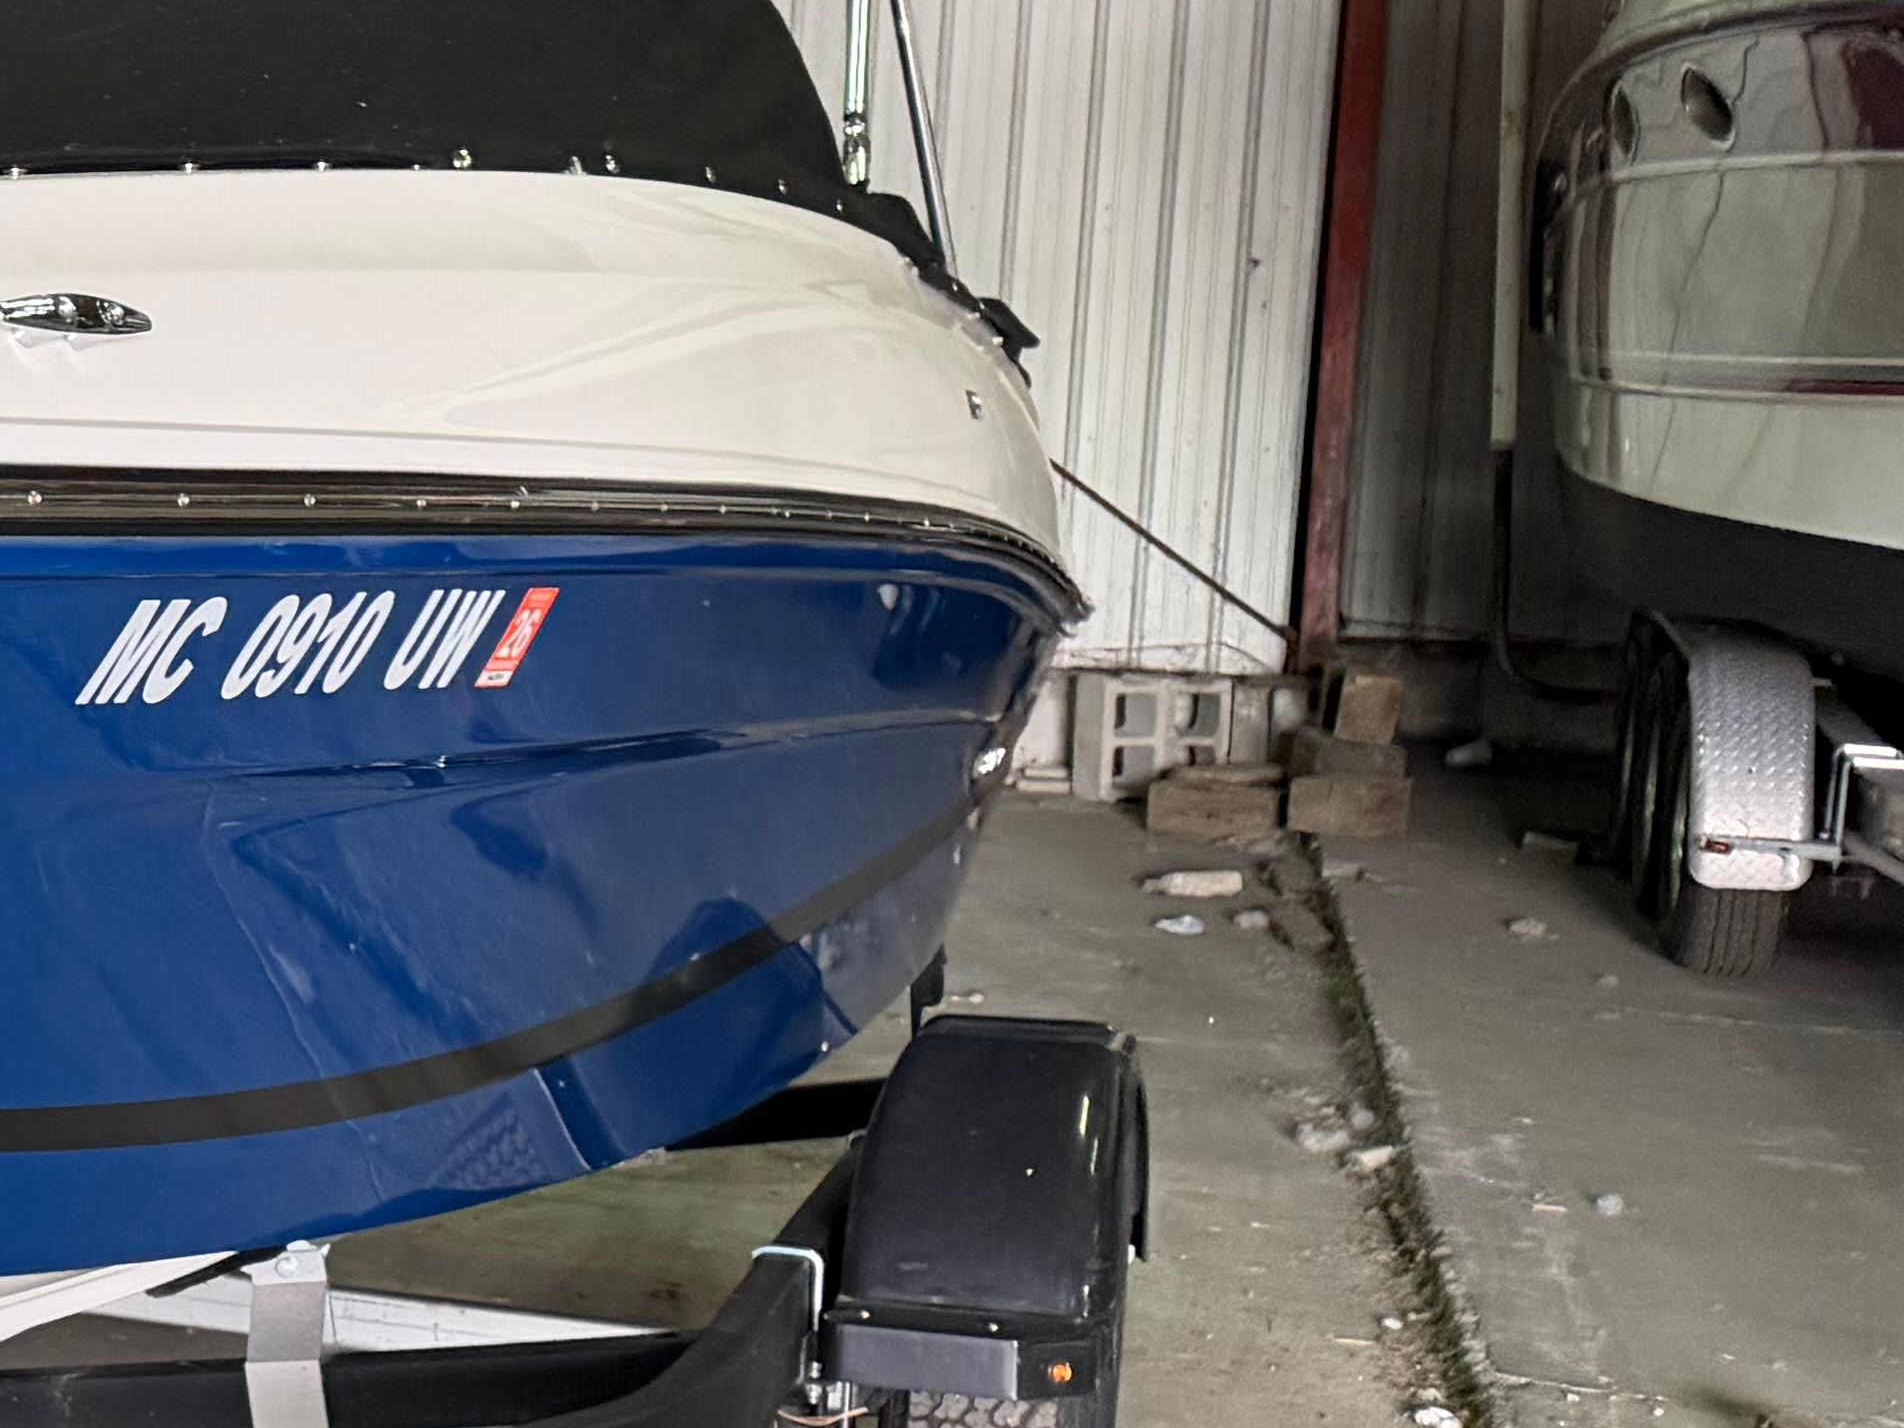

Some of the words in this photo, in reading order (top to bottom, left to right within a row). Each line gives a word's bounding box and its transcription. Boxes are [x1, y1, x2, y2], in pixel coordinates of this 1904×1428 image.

[75, 597, 228, 705] MC
[221, 590, 395, 700] 0910
[384, 588, 506, 689] UW
[496, 608, 542, 658] 26
